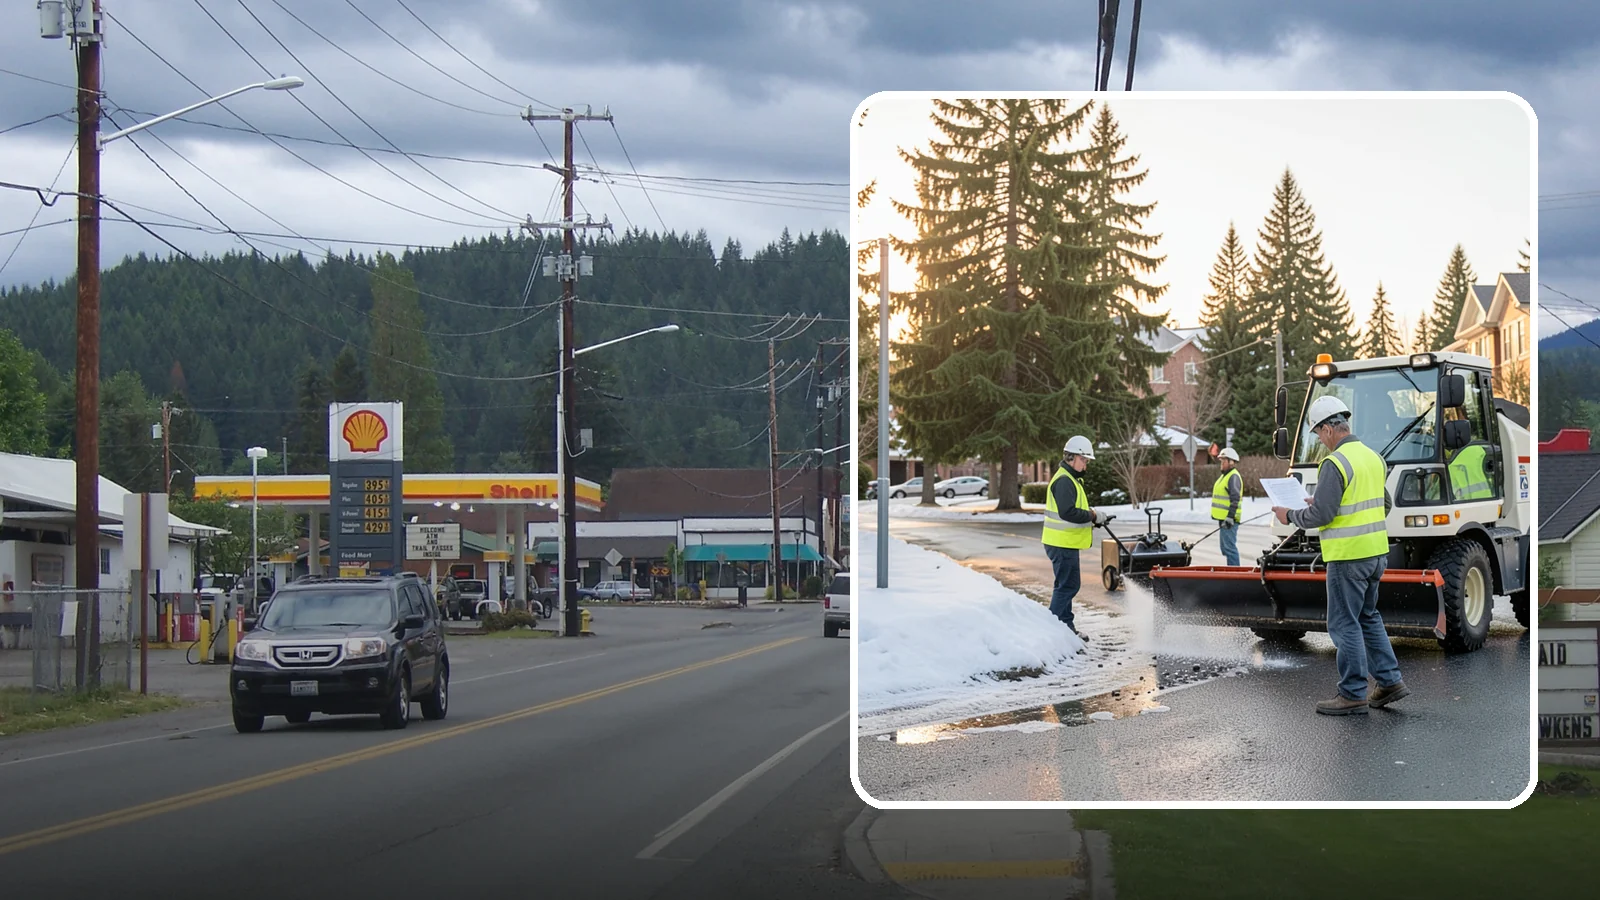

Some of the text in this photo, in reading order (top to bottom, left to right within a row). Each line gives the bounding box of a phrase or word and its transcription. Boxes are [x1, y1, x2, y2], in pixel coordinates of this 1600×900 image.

[366, 480, 383, 490] 395
[490, 484, 548, 499] Shell
[366, 494, 383, 504] 405
[366, 508, 383, 518] 415
[366, 522, 383, 532] 429
